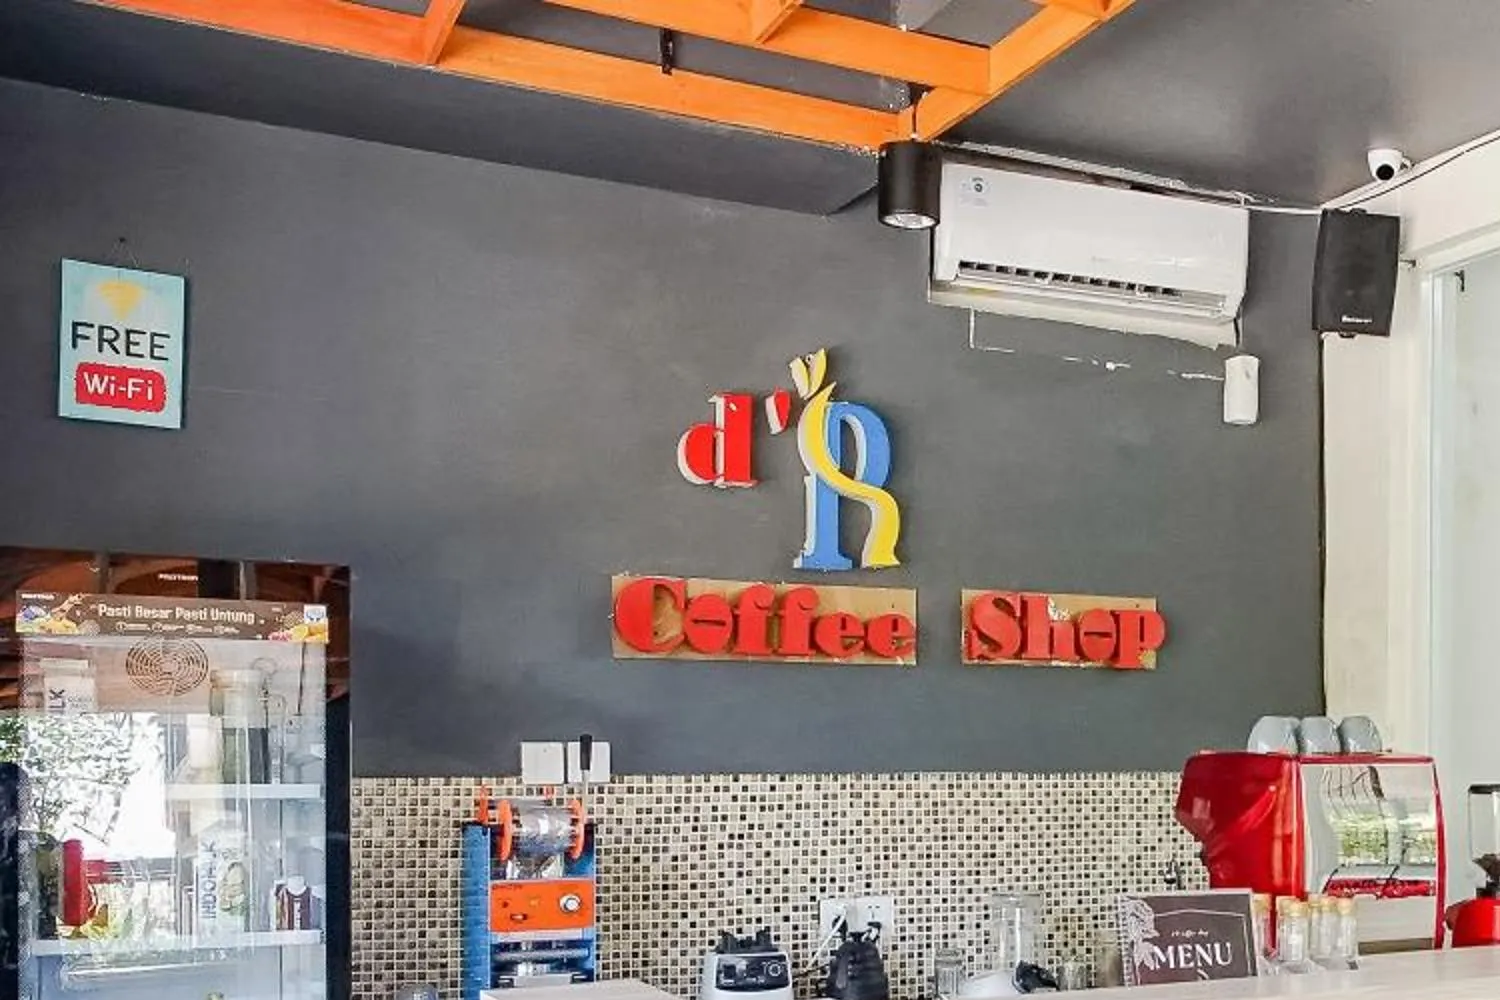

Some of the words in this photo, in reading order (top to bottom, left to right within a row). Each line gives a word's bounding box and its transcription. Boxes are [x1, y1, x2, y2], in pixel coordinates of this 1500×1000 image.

[70, 319, 171, 361] FREE
[83, 371, 153, 401] Wi-Fi
[98, 603, 131, 618] Pasti
[175, 606, 208, 620] Pasti
[210, 607, 255, 625] Untung
[613, 577, 916, 659] Coffee
[965, 592, 1165, 670] Shop
[1152, 941, 1232, 970] MENU
